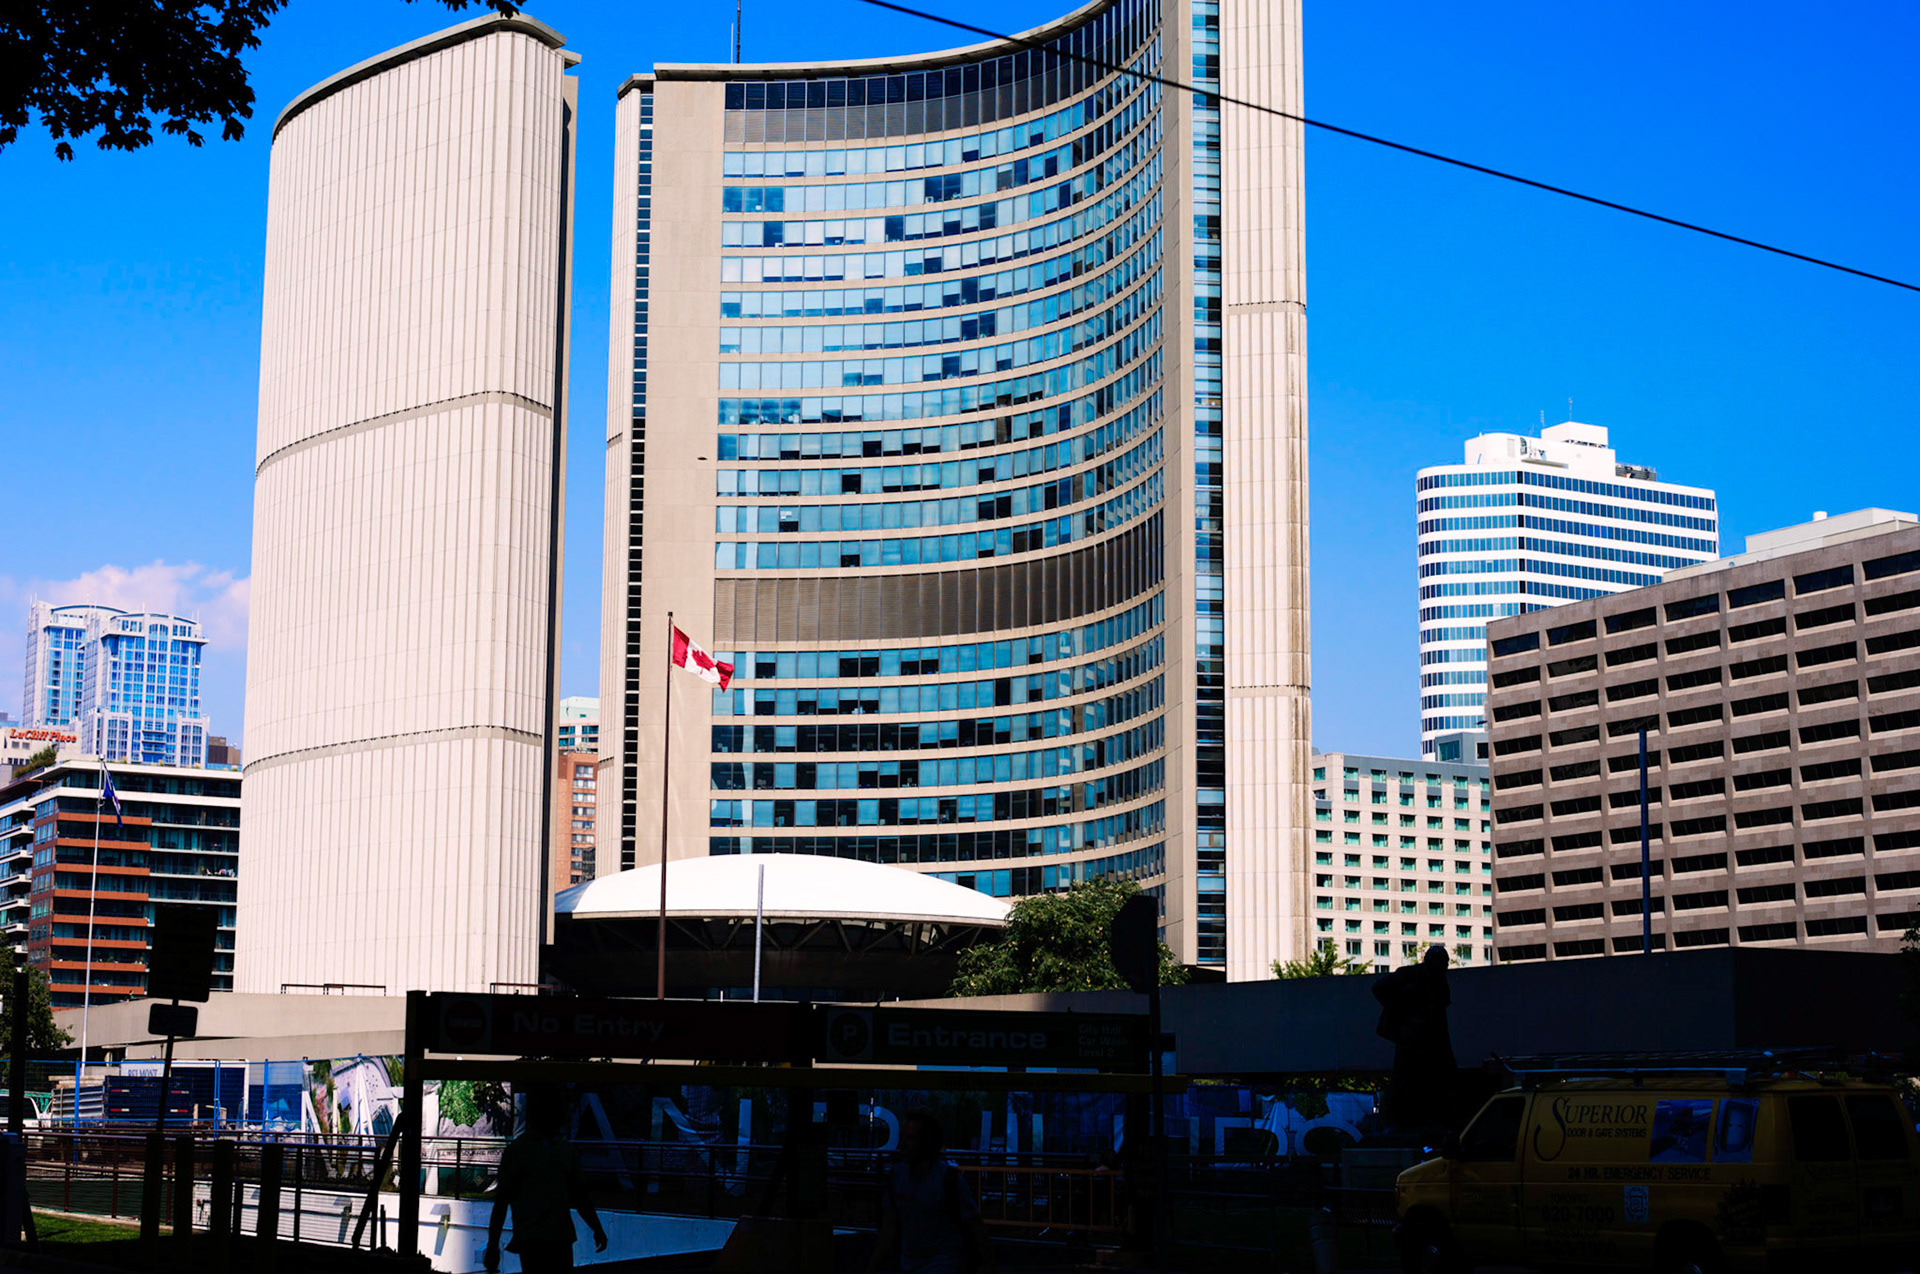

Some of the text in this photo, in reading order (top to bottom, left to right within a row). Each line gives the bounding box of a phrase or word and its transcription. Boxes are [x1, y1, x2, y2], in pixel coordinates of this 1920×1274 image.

[49, 731, 77, 743] Place
[512, 1010, 664, 1042] No Entry
[887, 1022, 1047, 1049] Entrance
[1078, 1035, 1097, 1046] Car
[1079, 1047, 1104, 1057] Level
[1534, 1096, 1648, 1161] SUPERIOR
[1567, 1127, 1586, 1137] DOOR
[1595, 1127, 1613, 1138] GATE
[1614, 1127, 1647, 1138] SYSTEMS
[1603, 1167, 1664, 1180] EMERGENCY
[1668, 1167, 1711, 1180] SERVICE
[1542, 1205, 1615, 1223] 620-7000
